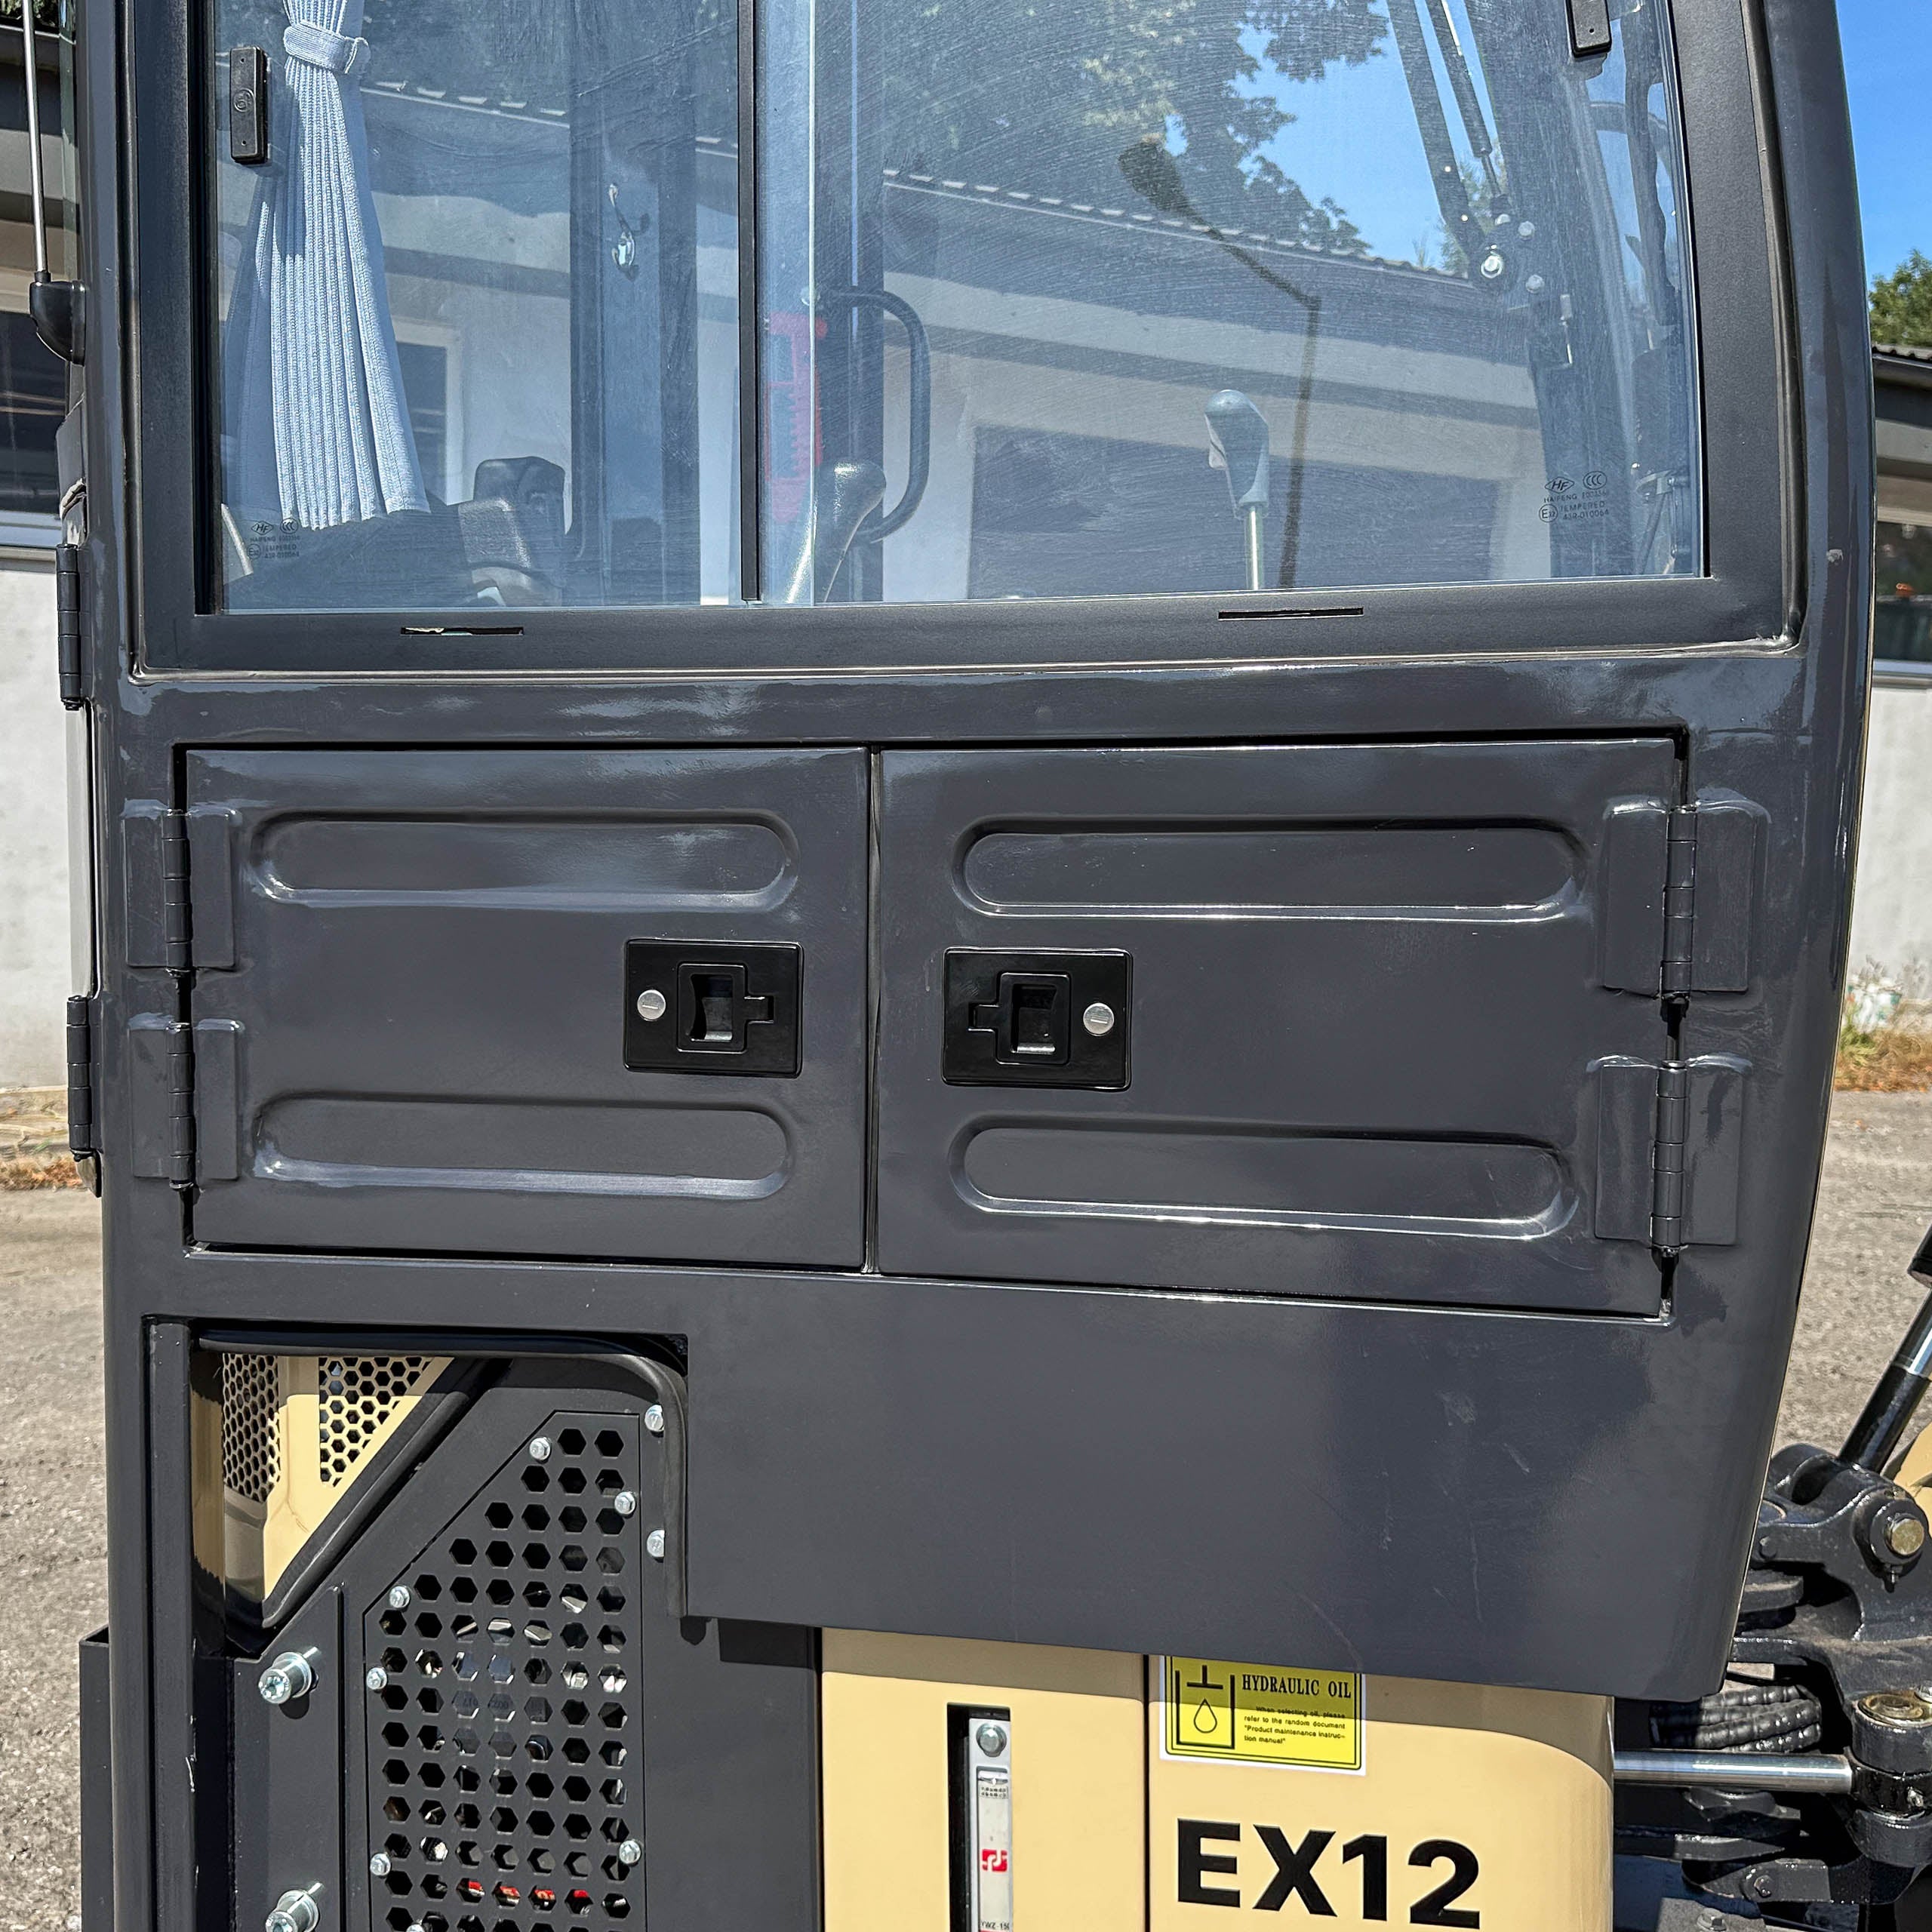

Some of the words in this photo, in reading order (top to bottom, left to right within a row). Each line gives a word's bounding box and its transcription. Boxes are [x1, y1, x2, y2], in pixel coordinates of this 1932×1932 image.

[1560, 500, 1605, 512] TEMPERED
[1242, 1674, 1319, 1696] HYDRAULIC
[1328, 1681, 1351, 1698] OIL
[1277, 1708, 1307, 1717] selecting
[1313, 1721, 1345, 1729] document
[1275, 1727, 1316, 1737] maintenance
[1177, 1817, 1480, 1929] EX12
